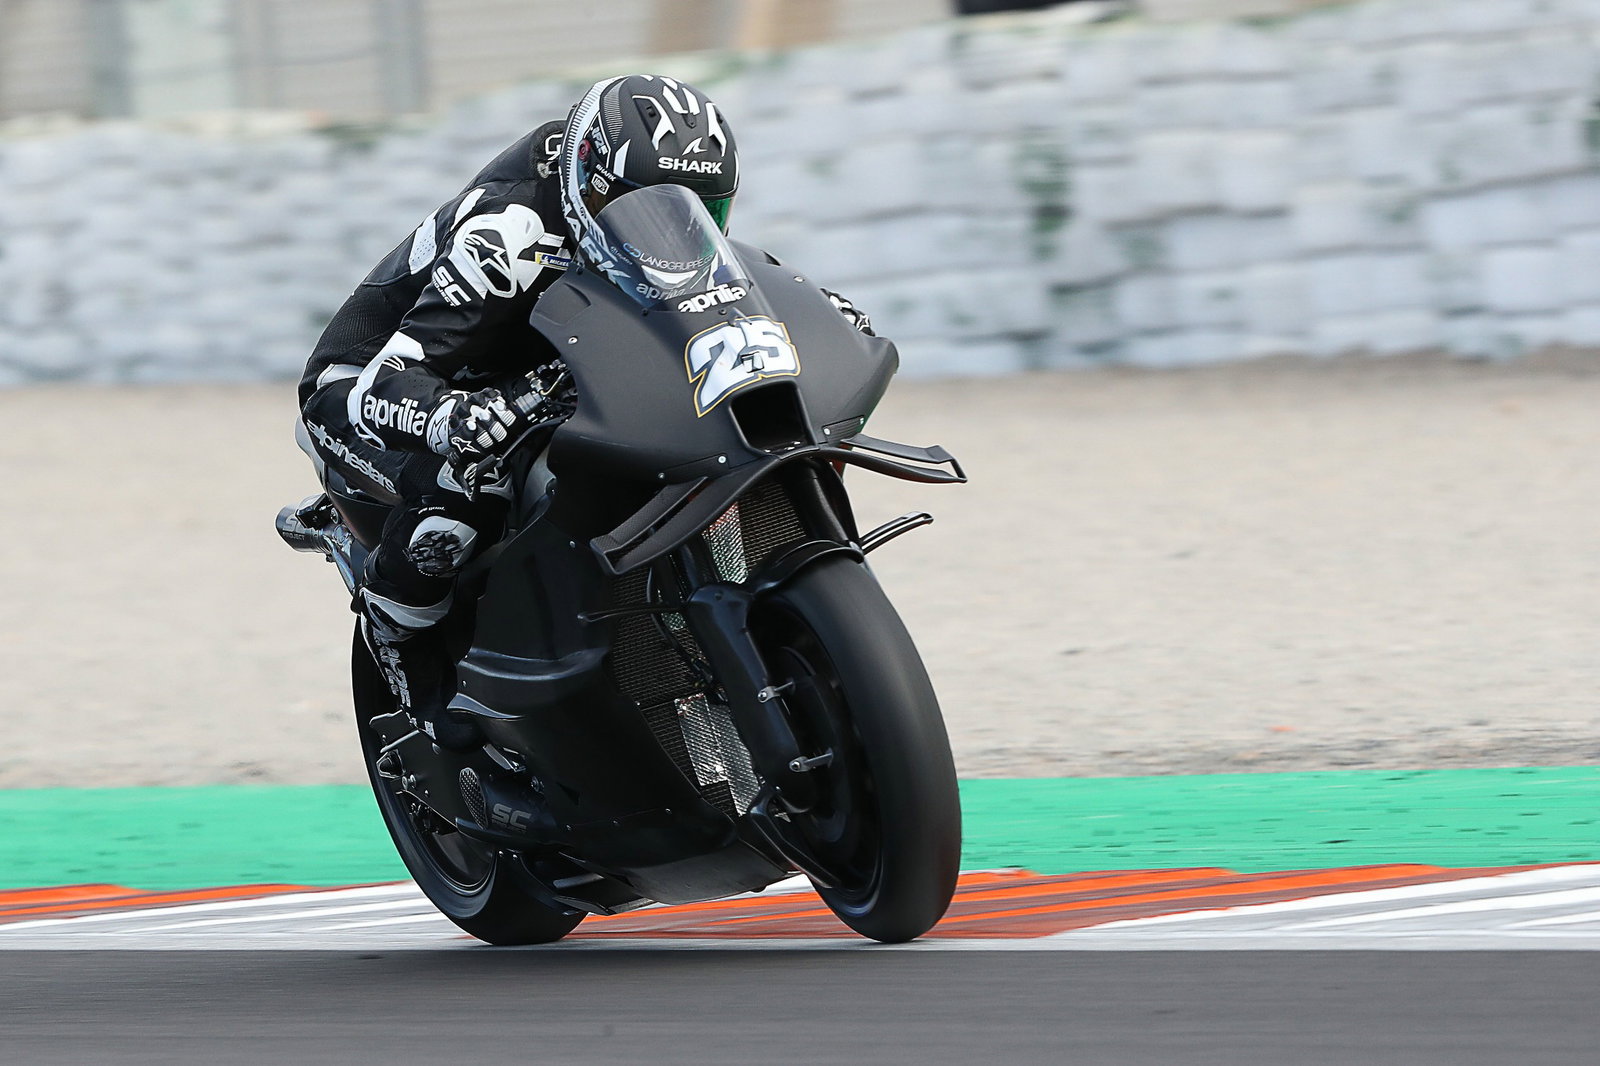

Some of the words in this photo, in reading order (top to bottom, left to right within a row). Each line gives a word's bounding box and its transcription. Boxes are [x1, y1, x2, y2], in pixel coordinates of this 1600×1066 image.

[595, 163, 617, 182] SHARK
[657, 156, 723, 175] SHARK
[432, 265, 472, 307] SC
[677, 282, 748, 313] aprilia
[684, 315, 802, 418] 25
[363, 394, 428, 437] aprilia
[491, 803, 532, 830] SC
